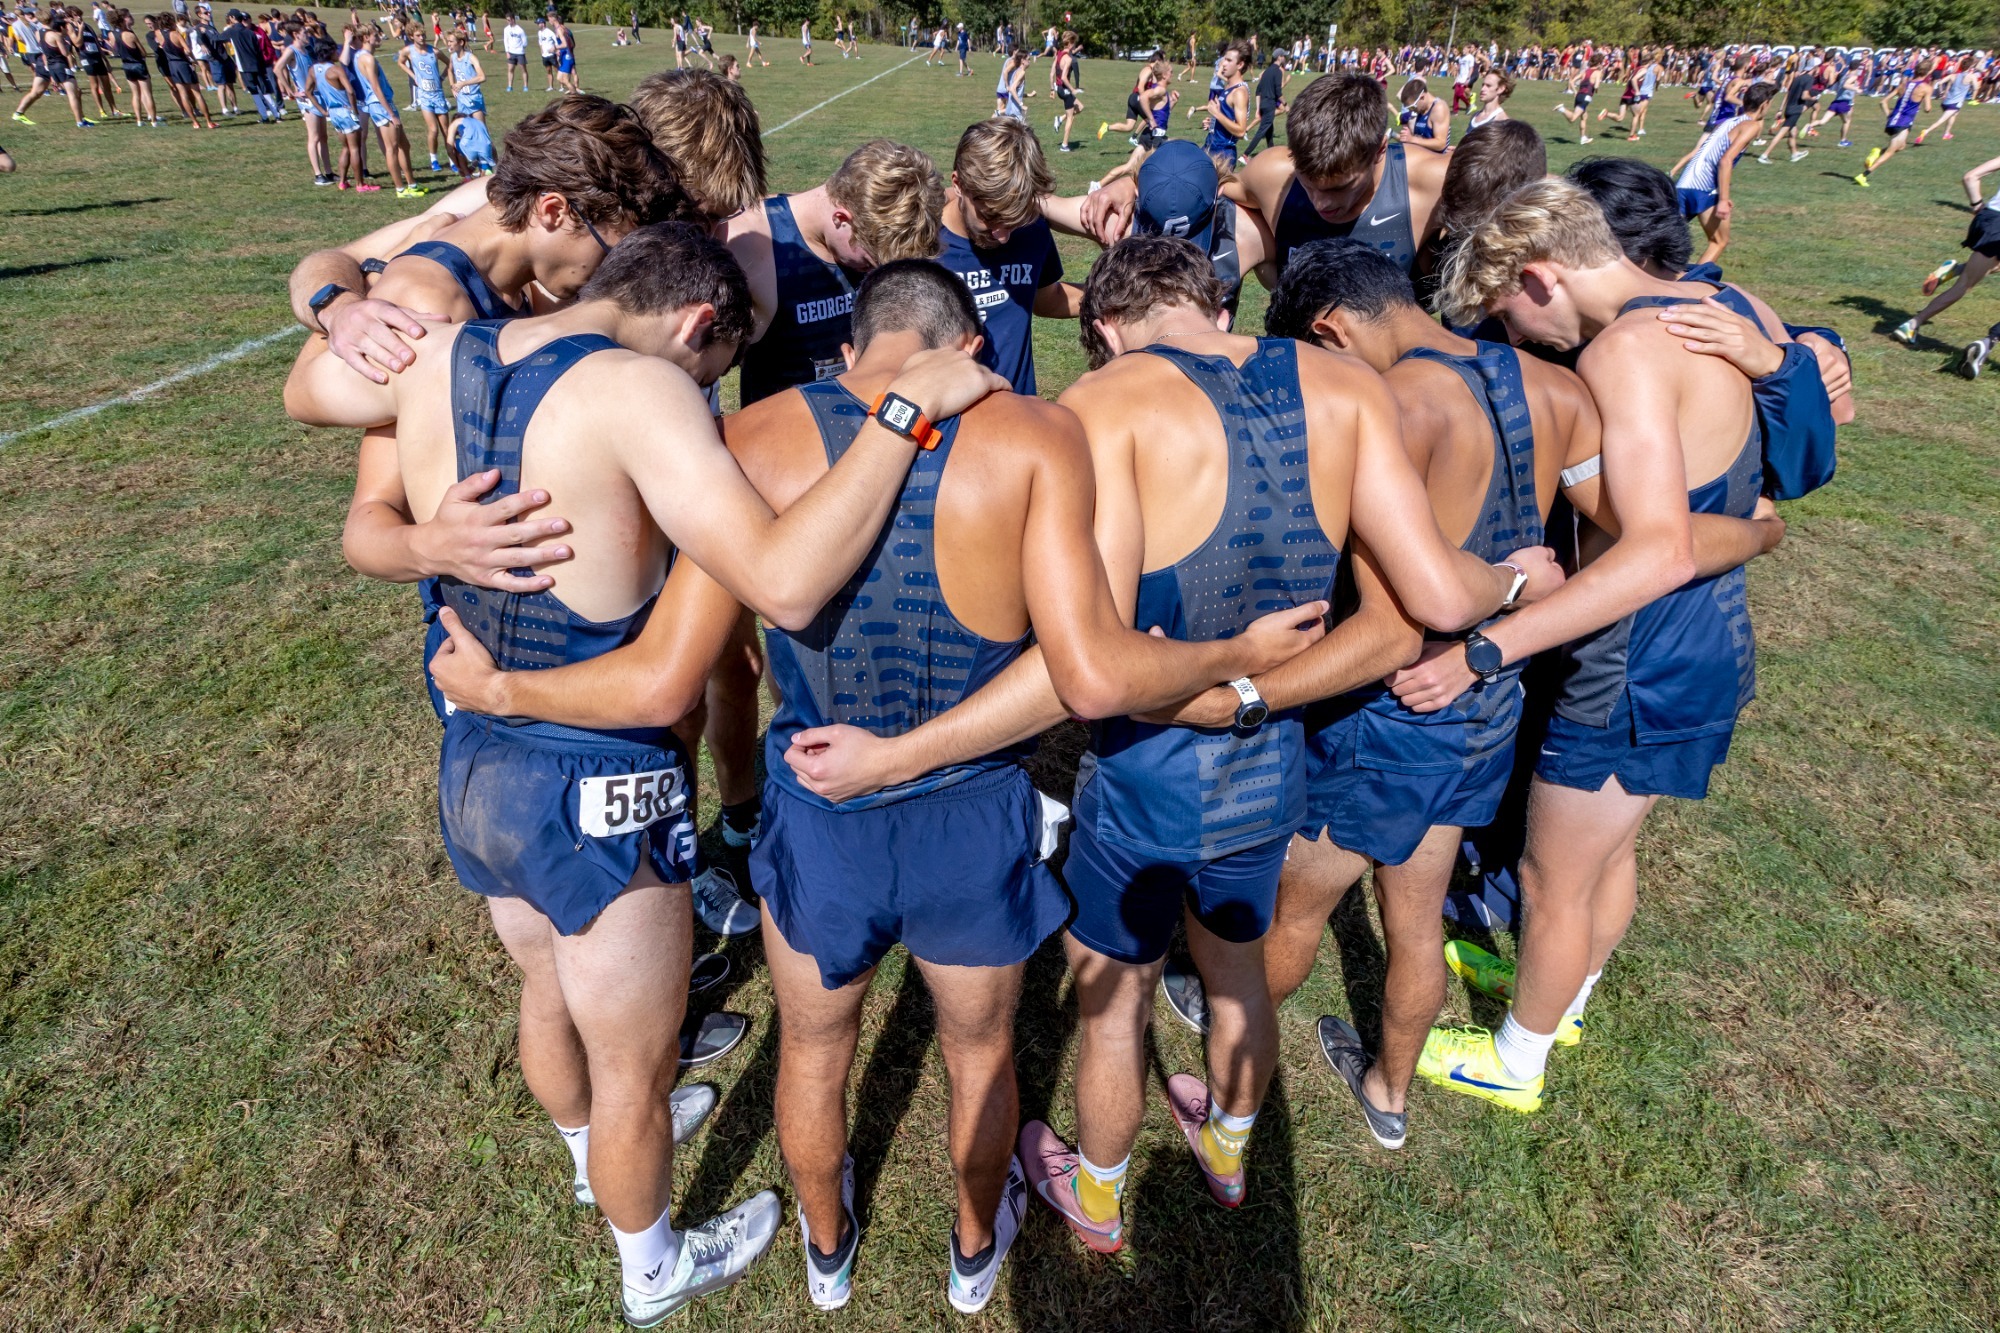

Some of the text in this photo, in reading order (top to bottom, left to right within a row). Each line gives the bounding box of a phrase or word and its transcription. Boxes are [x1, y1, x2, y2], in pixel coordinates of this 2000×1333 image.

[999, 263, 1033, 285] FOX
[796, 292, 854, 324] GEORGE
[986, 292, 1006, 304] FIELD
[604, 771, 675, 827] 558
